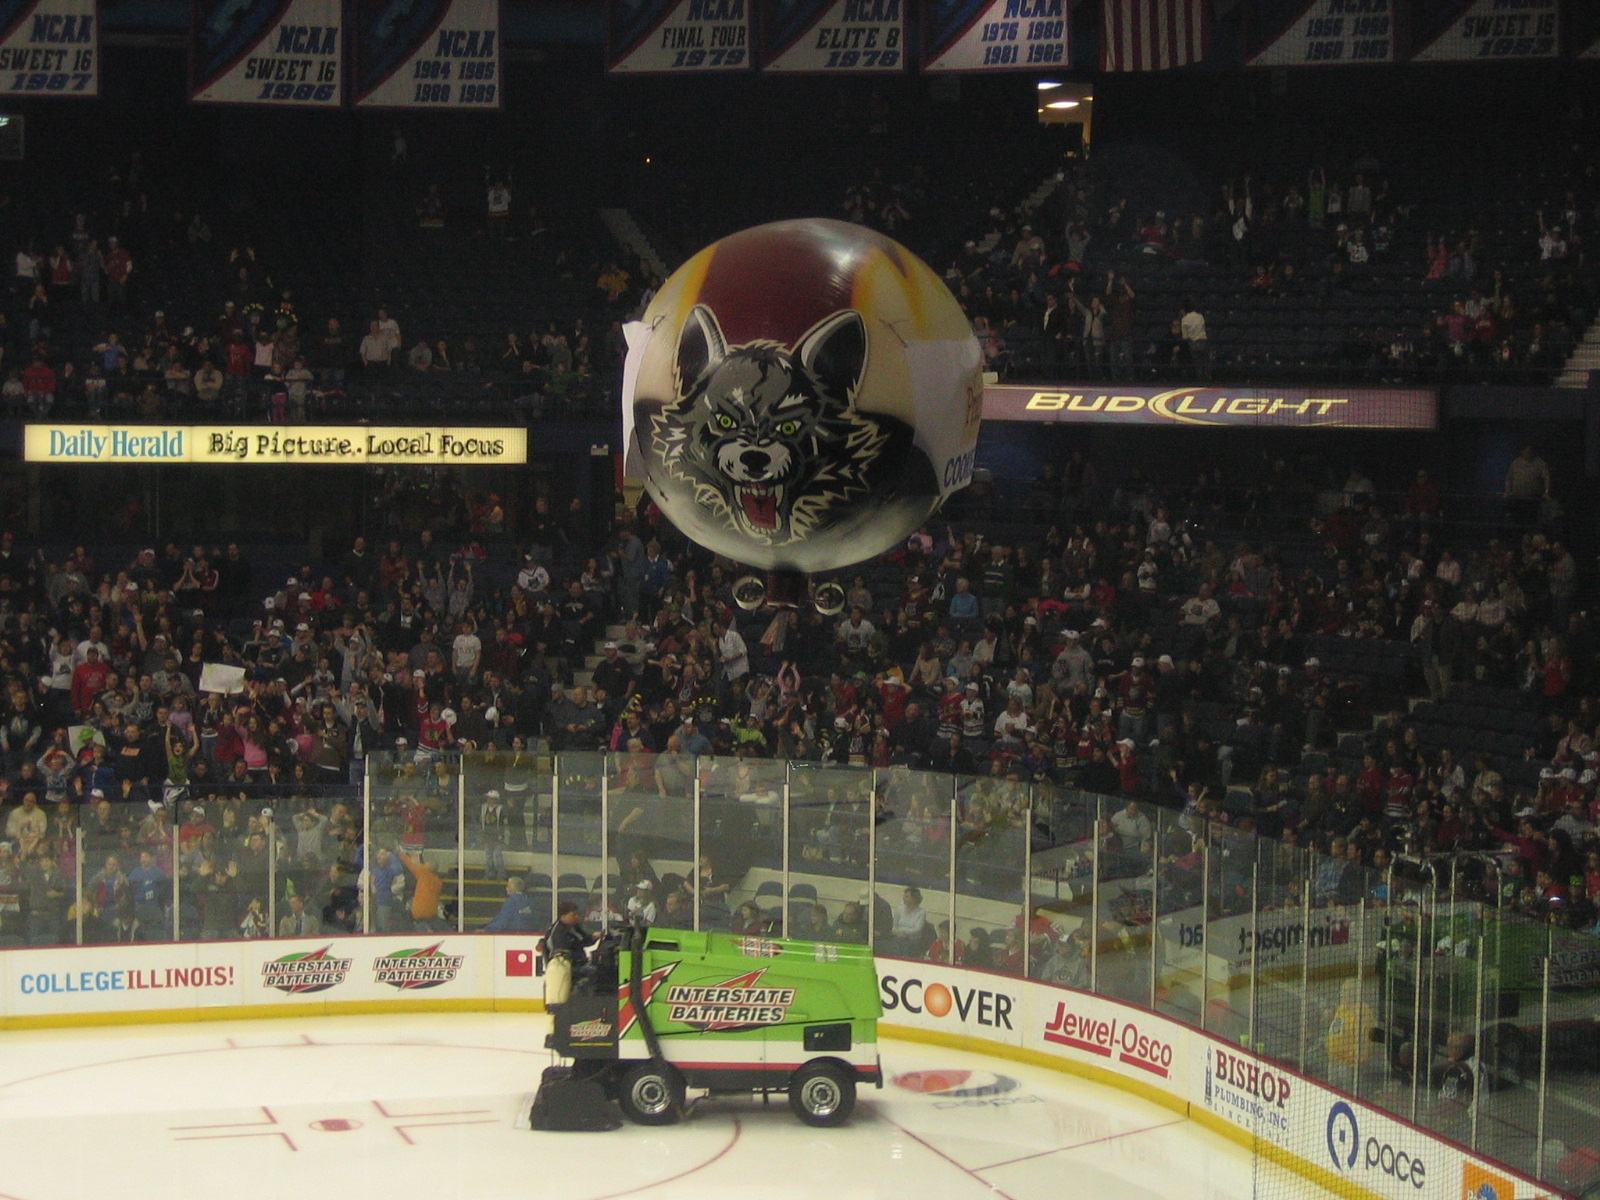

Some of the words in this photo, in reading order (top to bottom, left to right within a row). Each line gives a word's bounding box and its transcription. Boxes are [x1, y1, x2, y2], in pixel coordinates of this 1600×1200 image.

[30, 15, 94, 43] NCAA
[275, 25, 338, 55] NCAA
[661, 27, 704, 49] FINAL
[710, 25, 746, 47] FOUR
[816, 27, 880, 49] ELITE
[886, 27, 900, 48] 8
[981, 22, 1019, 42] 1976
[1026, 20, 1064, 40] 1980
[435, 30, 496, 57] NCAA
[983, 44, 1019, 65] 1981
[1026, 43, 1064, 63] 1982
[0, 49, 68, 71] SWEET
[74, 49, 93, 71] 16
[672, 49, 747, 67] 1979
[824, 50, 900, 68] 1978
[245, 58, 312, 81] SWEET
[317, 60, 337, 82] 16
[10, 73, 93, 90] 1987
[1025, 391, 1143, 412] BUD
[1177, 397, 1349, 415] LIGHT
[48, 429, 107, 459] Daily
[112, 429, 183, 457] Herald
[210, 433, 249, 458] Big
[440, 435, 505, 456] Focus
[264, 960, 350, 974] INTERSTATE
[375, 956, 461, 970] INTERSTATE
[266, 973, 344, 986] BATTERIES
[377, 969, 455, 982] BATTERIES
[667, 985, 794, 1005] INTERSTATE
[671, 1005, 785, 1023] BATTERIES
[1045, 1001, 1173, 1068] Jewel-Osco
[1215, 1049, 1291, 1110] BISHOP
[1366, 1136, 1426, 1190] pace
